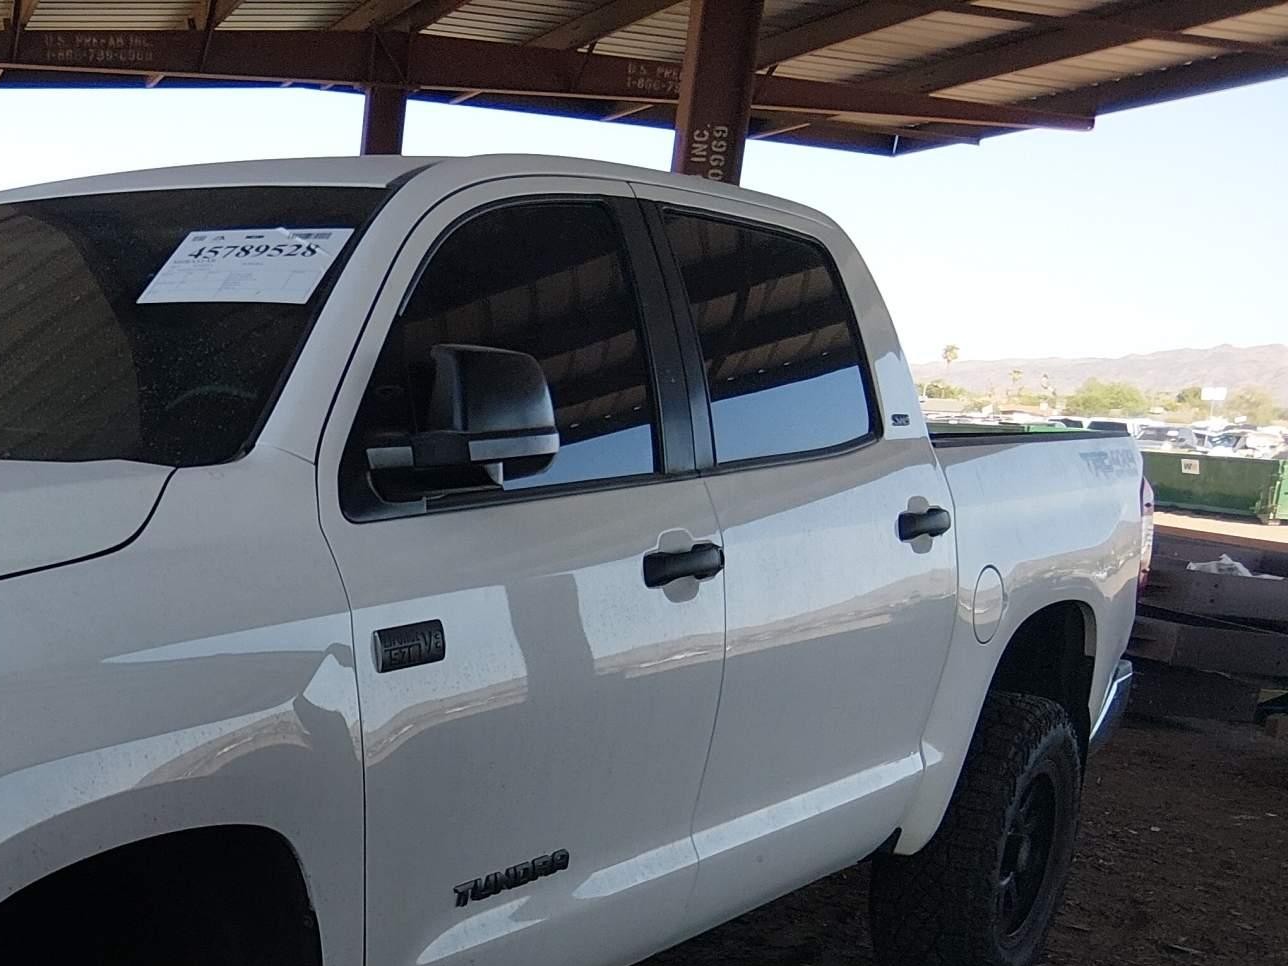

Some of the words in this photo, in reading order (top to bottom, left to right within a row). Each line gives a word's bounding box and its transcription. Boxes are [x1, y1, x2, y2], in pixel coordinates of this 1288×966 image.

[690, 123, 711, 163] INC.
[187, 243, 321, 259] 45789528
[453, 848, 570, 908] TUNDRA
